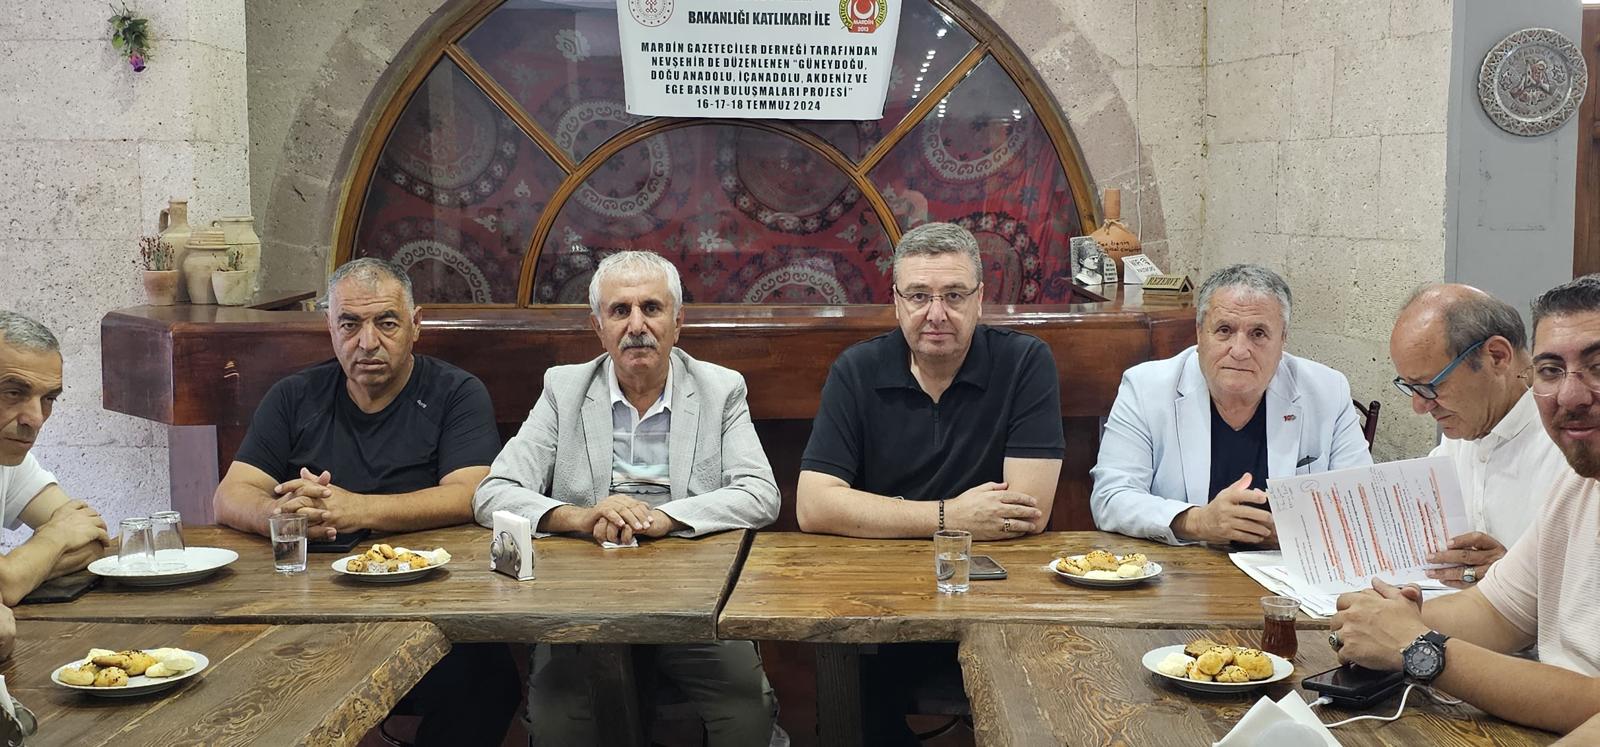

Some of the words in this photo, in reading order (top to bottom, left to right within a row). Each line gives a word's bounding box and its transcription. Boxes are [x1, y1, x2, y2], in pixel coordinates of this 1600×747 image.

[688, 9, 750, 25] BAKANLIĞI
[752, 12, 812, 26] KATLIKARI
[814, 10, 831, 26] İLE
[641, 41, 684, 53] MARDİN
[687, 42, 758, 55] GAZETECİLER
[760, 43, 807, 56] DERNEĞİ
[809, 45, 878, 56] TARAFINDAN
[651, 56, 705, 69] NEVŞEHİR
[707, 57, 721, 68] DE
[723, 56, 790, 69] DÜZENLENEN
[650, 69, 680, 81] DOĞU
[682, 71, 736, 82] ANADOLU,
[738, 70, 804, 84] İÇANADOLU,
[806, 72, 853, 84] AKDENİZ
[855, 73, 868, 84] VE
[665, 84, 684, 95] EGE
[687, 84, 720, 96] BASIN
[723, 85, 800, 97] BULUŞMALARI
[697, 98, 743, 110] 16-17-18
[746, 99, 791, 111] TEMMUZ
[793, 100, 821, 111] 2024
